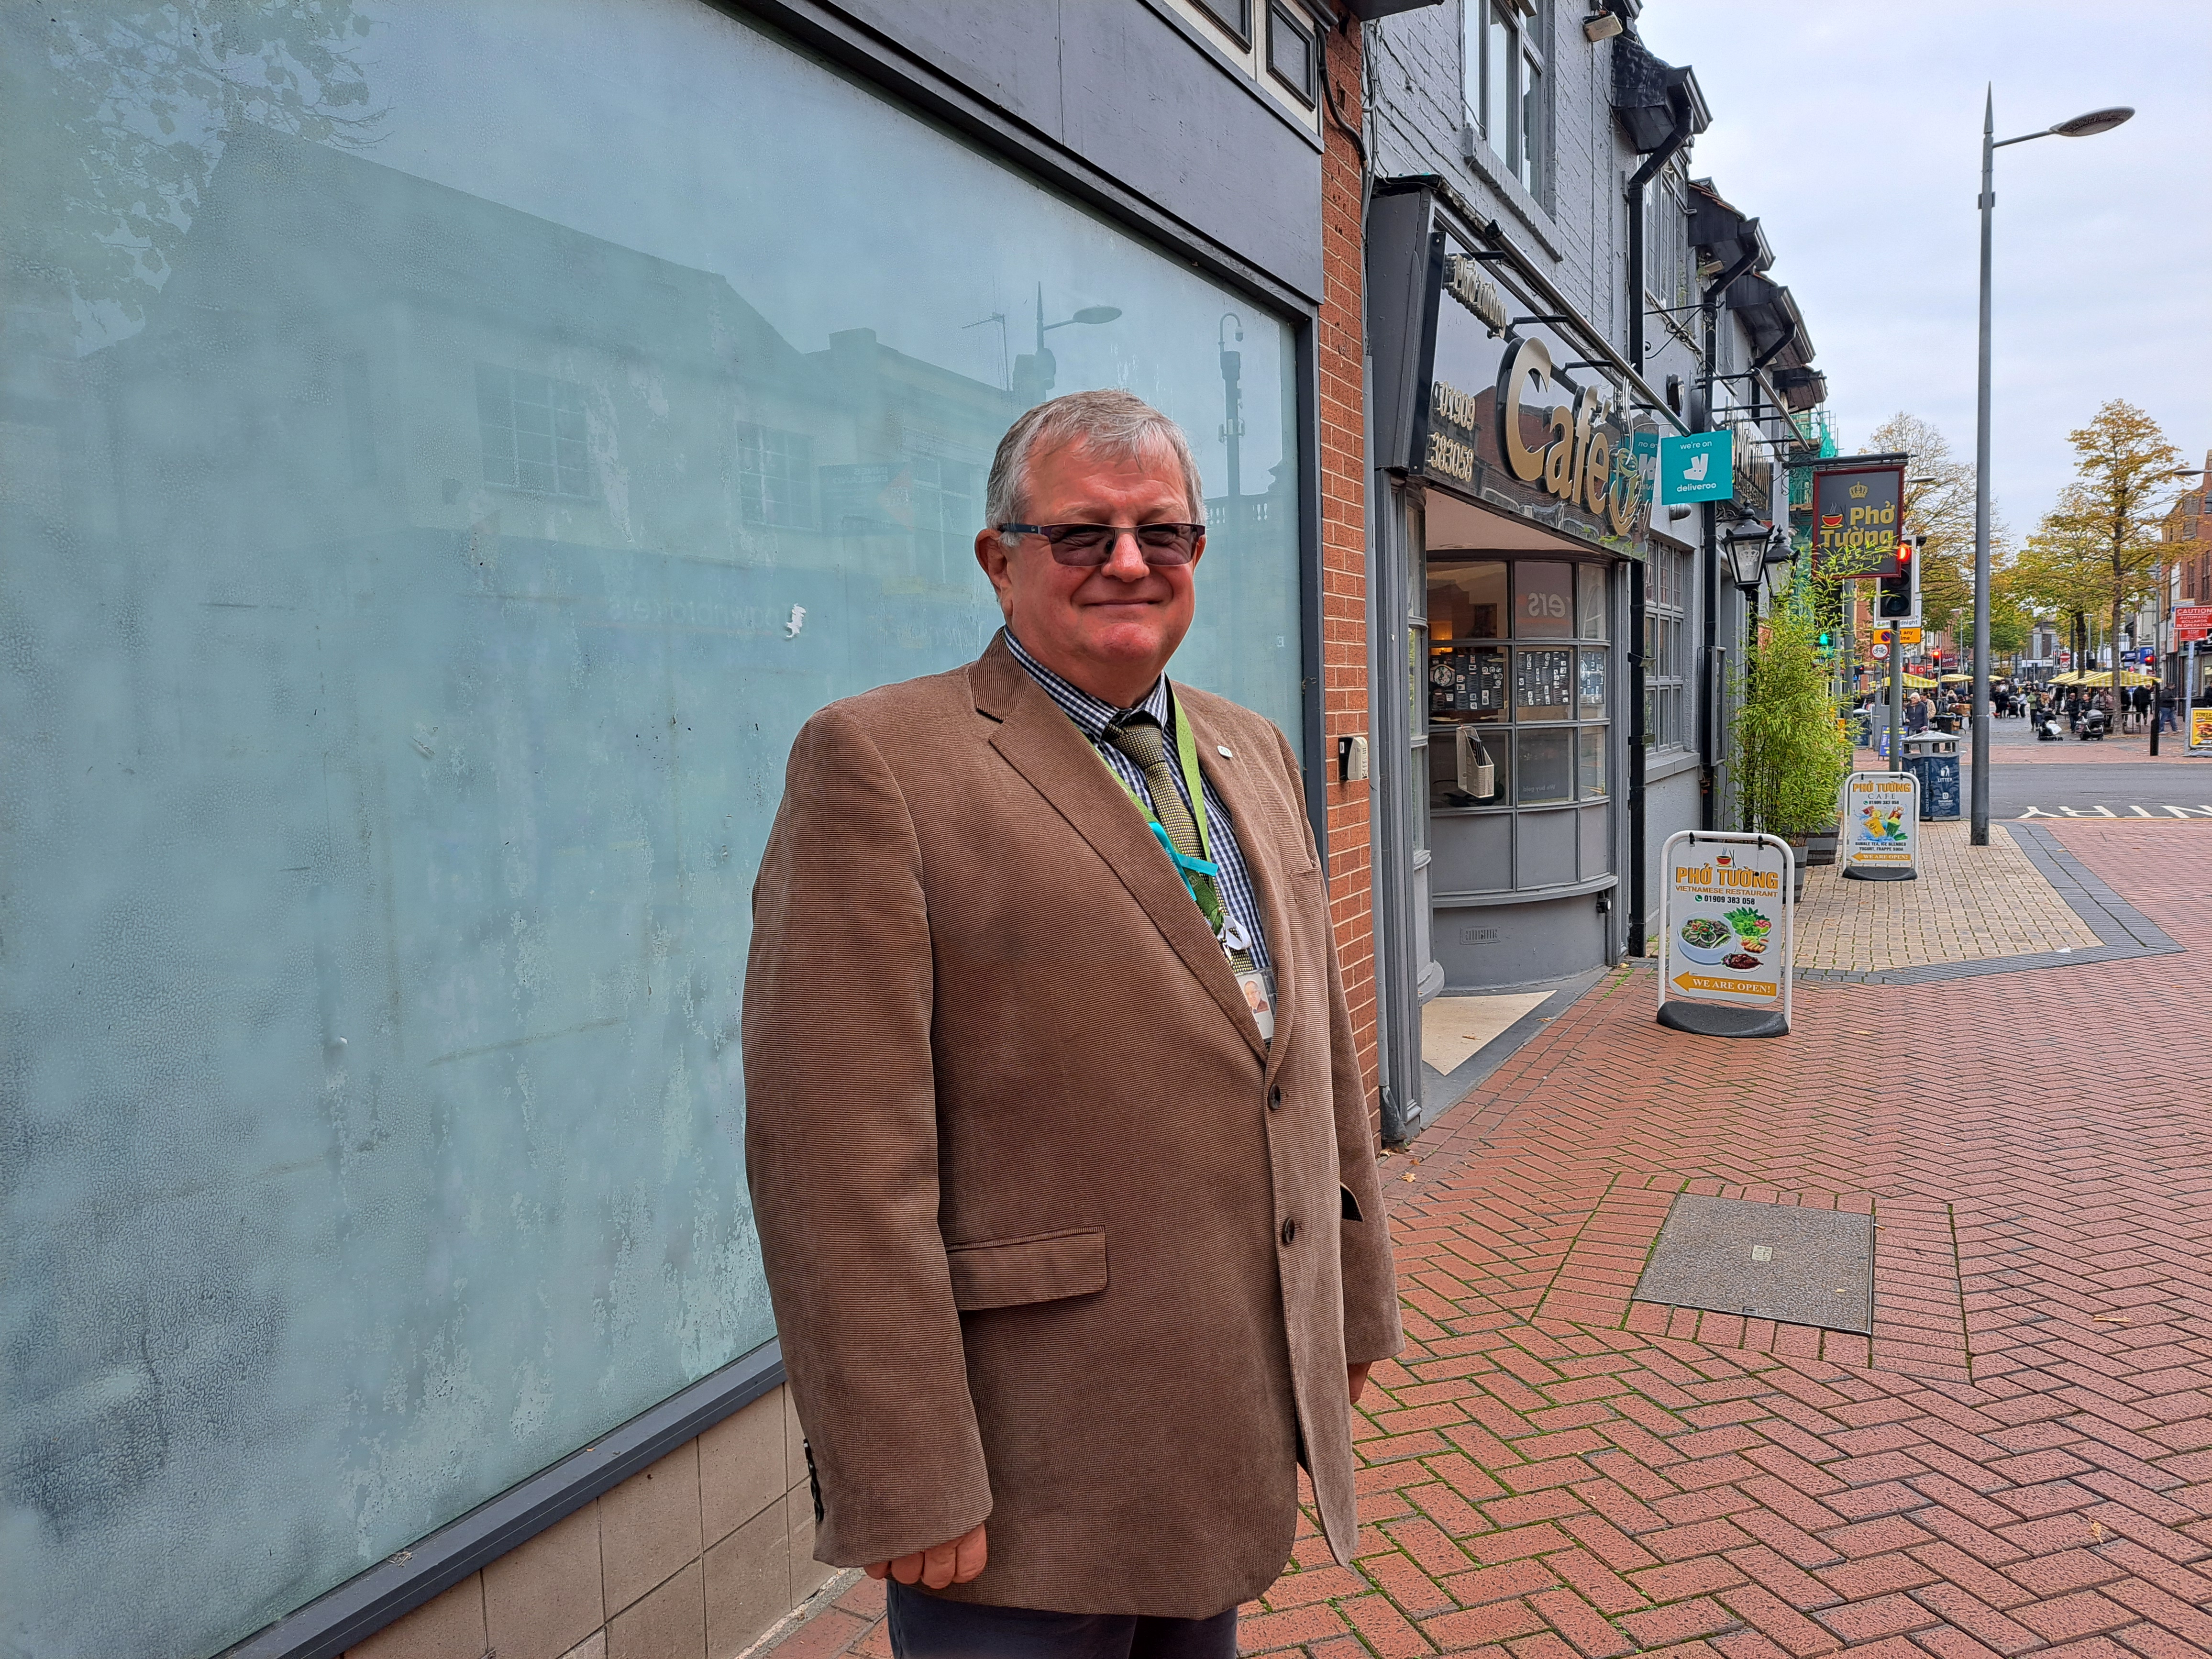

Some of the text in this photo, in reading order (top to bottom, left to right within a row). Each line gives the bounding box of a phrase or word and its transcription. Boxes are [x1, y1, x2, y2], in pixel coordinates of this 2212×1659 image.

[1440, 381, 1475, 431] 01909
[1502, 337, 1611, 514] Café
[1680, 442, 1700, 450] we're
[1431, 432, 1474, 482] 383058
[1676, 482, 1717, 492] deliveroo
[1850, 500, 1896, 525] Phở
[1820, 526, 1894, 549] Tường
[1852, 780, 1874, 793] PHỞ
[2016, 805, 2212, 819] NTRY
[1675, 863, 1779, 889] PHỞ TƯỜNG
[1675, 885, 1778, 897] VIETNAMESE RESTAURANT
[1704, 895, 1725, 903] 01909
[1727, 896, 1741, 904] 383
[1692, 978, 1771, 994] WE ARE OPEN!
